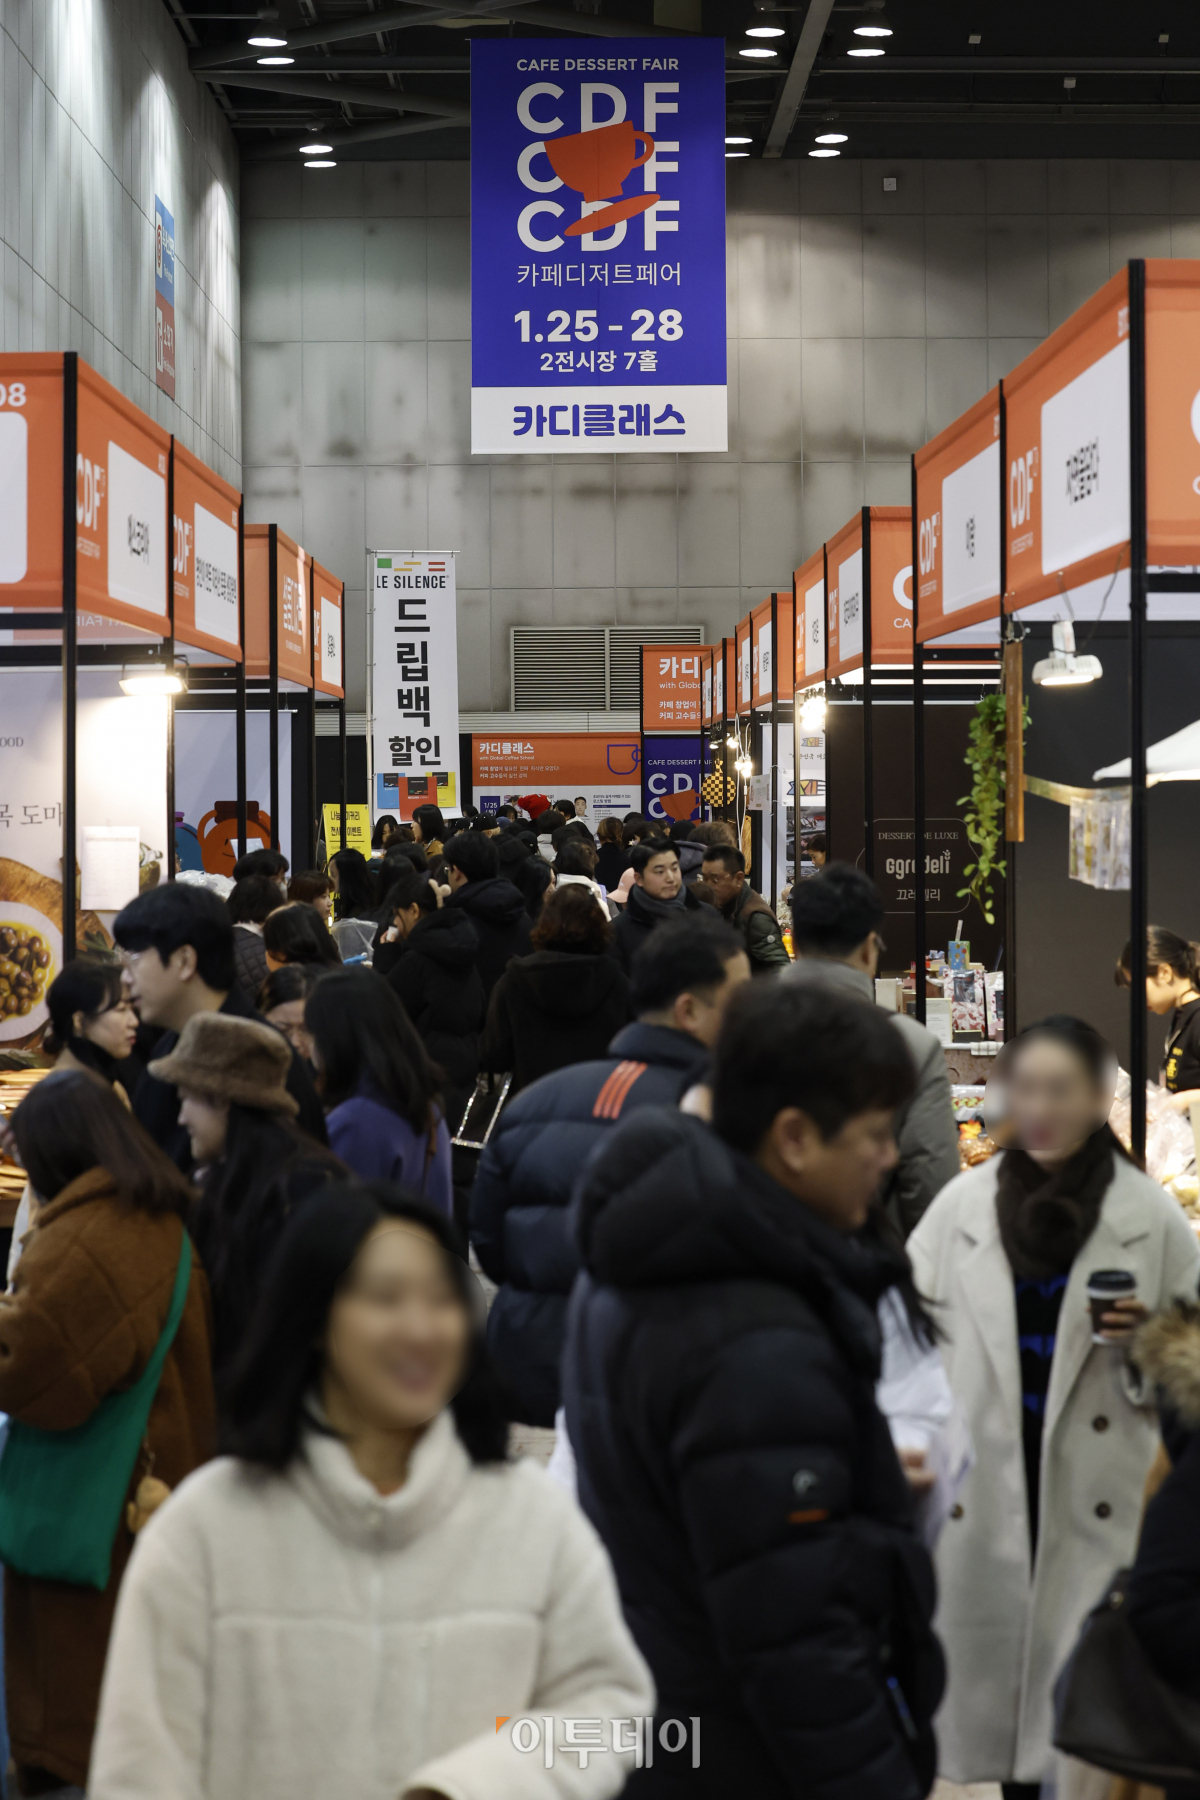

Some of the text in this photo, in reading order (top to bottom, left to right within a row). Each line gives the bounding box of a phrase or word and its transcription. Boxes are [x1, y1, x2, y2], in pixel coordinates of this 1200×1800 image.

[516, 58, 679, 71] CAFE DESSERT FAIR
[516, 82, 680, 134] CDF
[516, 141, 680, 193] CF
[516, 200, 680, 252] CDF
[517, 262, 681, 287] 카페디저트페어
[514, 309, 599, 343] 1.25
[630, 309, 684, 342] 28
[540, 350, 658, 372] 2전시장 7홀
[512, 403, 686, 437] 카디클래스
[1010, 451, 1034, 529] CDF
[920, 514, 937, 576] CDF
[376, 575, 446, 588] LE SILENCE
[394, 599, 430, 727] 드립백
[659, 656, 699, 679] 카디
[659, 701, 697, 709] 카페 창업에
[659, 712, 674, 720] 커피
[388, 736, 441, 766] 할인
[480, 742, 534, 754] 카디클래스
[20, 802, 64, 828] 도마
[935, 832, 959, 840] LUXE
